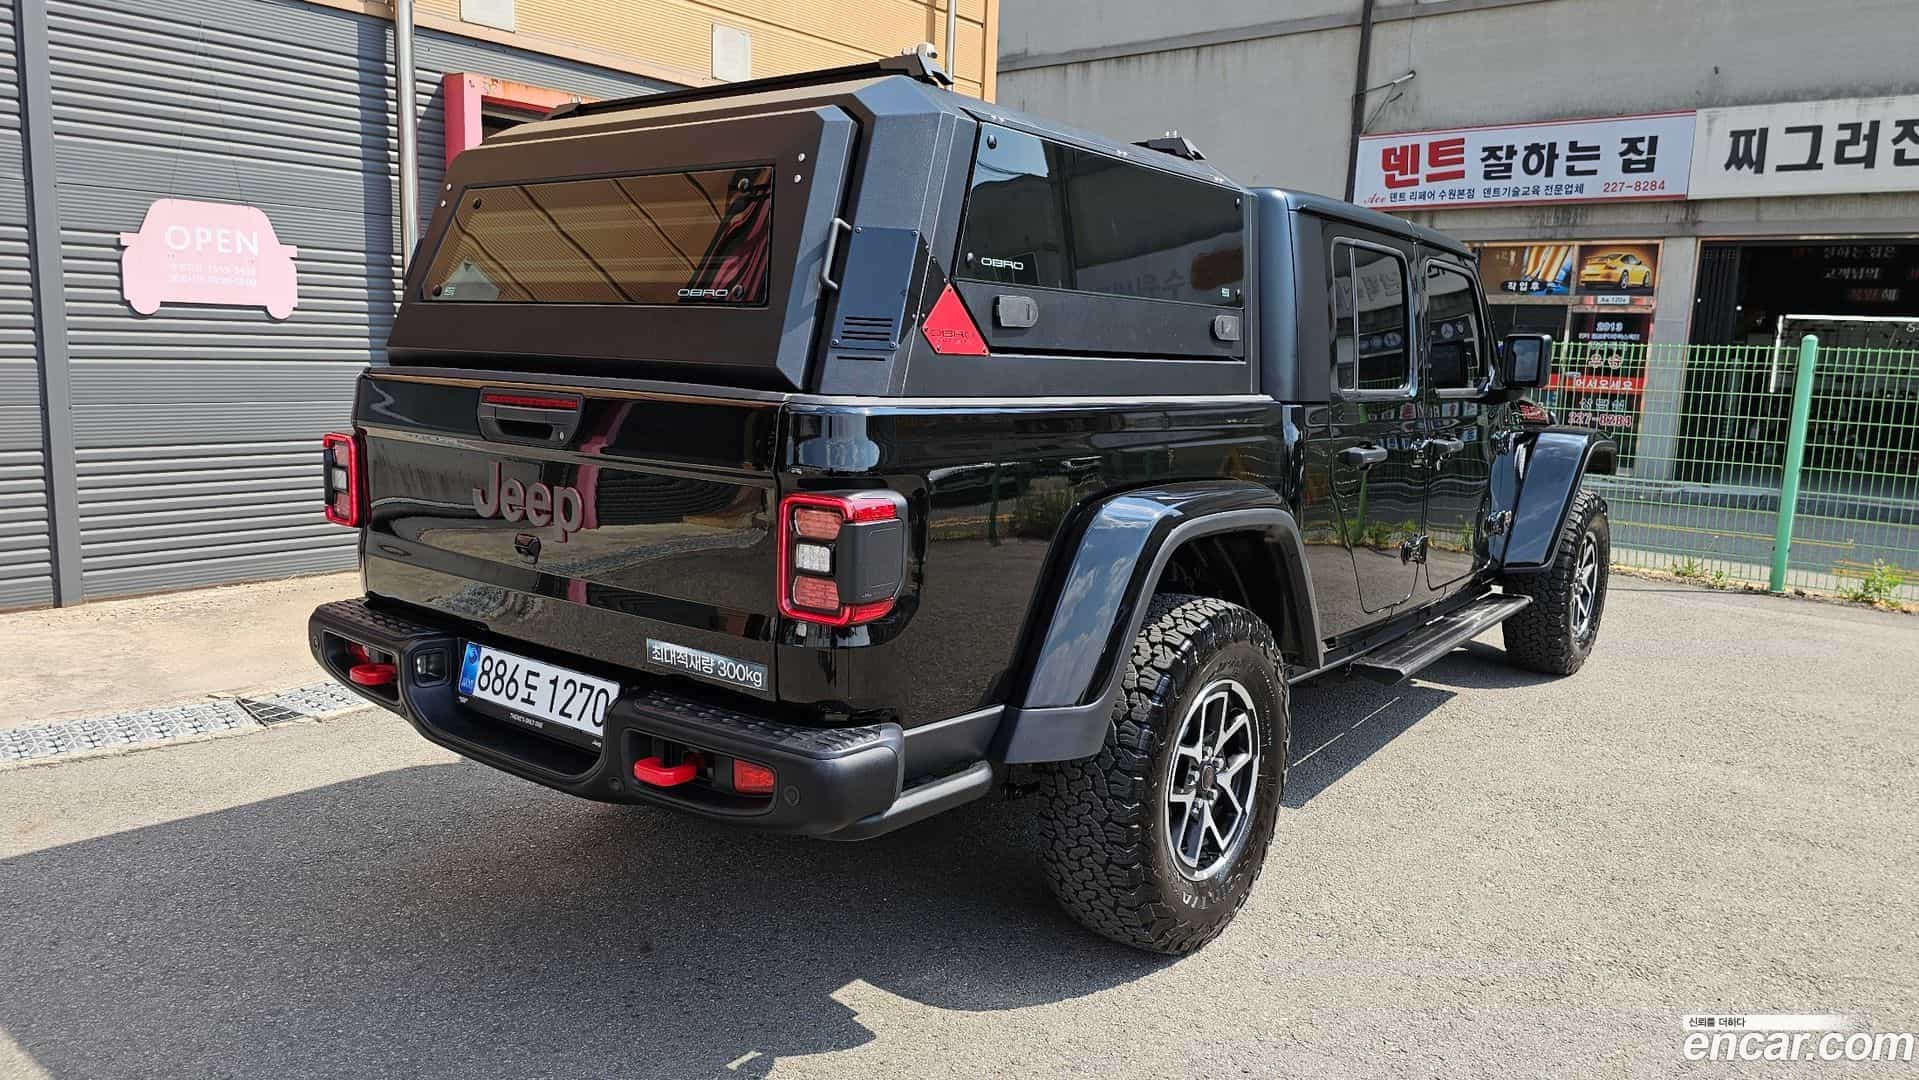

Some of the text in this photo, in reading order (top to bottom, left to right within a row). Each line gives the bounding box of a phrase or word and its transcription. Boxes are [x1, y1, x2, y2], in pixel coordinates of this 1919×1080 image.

[1382, 135, 1658, 189] 덴트 잘하는 집
[1409, 189, 1436, 201] 리페어
[1438, 187, 1475, 200] 수원본점
[1544, 183, 1585, 196] 전문업체
[1603, 180, 1665, 193] 227-8284
[164, 225, 259, 257] OPEN
[981, 257, 1024, 270] OBRO
[677, 288, 728, 297] OBRO
[1576, 379, 1633, 390] 어서오세요
[1567, 411, 1632, 427] 227-8284
[473, 461, 584, 543] Jeep
[652, 645, 763, 687] 최대적재량 300kg
[478, 655, 610, 727] 886도 1270
